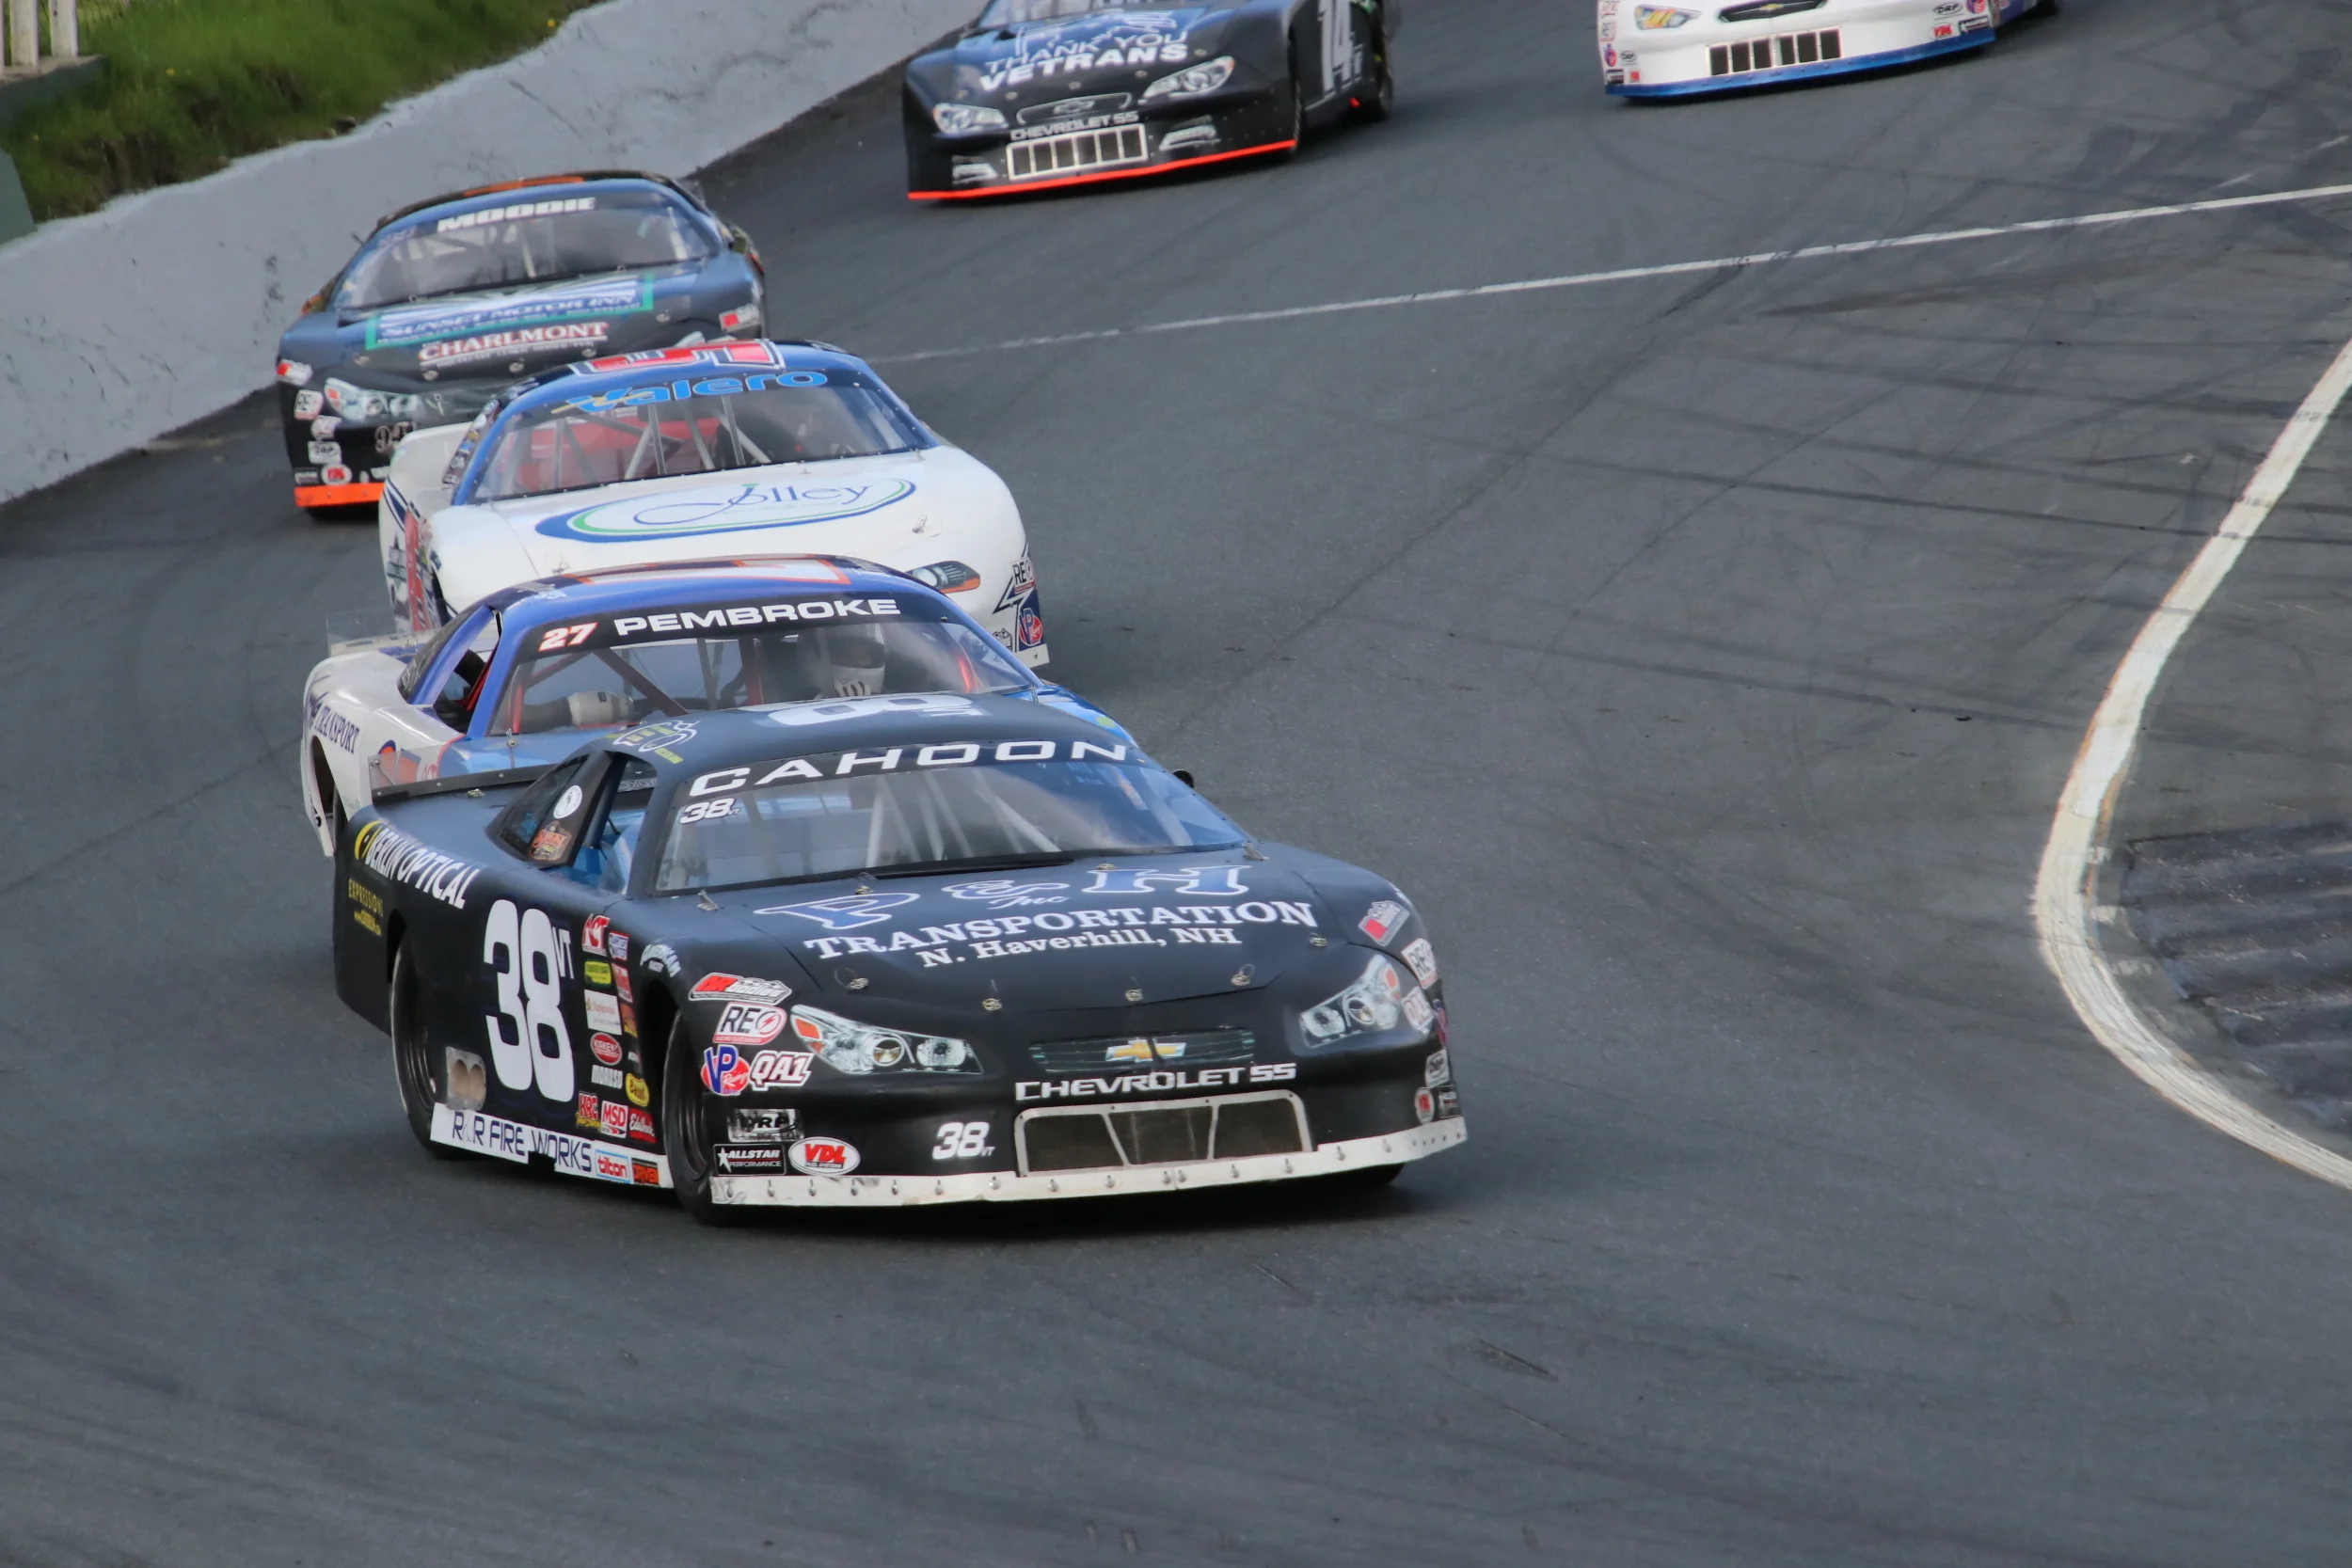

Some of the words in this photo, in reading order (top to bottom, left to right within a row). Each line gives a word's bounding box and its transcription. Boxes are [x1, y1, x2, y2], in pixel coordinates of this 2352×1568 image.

[978, 42, 1188, 92] VETRANS
[984, 41, 1099, 75] THANK
[1112, 30, 1188, 50] YOU
[1010, 115, 1111, 141] CHEVROLET
[437, 198, 596, 233] MOODIE
[419, 321, 610, 361] CHARLMONT
[564, 371, 829, 414] Valero
[537, 622, 598, 653] 27
[613, 599, 900, 637] PEMBROKE
[314, 705, 361, 755] TRANSPORT
[688, 740, 1127, 798] CAHOON
[679, 798, 736, 824] 38
[396, 847, 481, 910] OPTICAL
[1082, 864, 1252, 895] H
[988, 895, 1071, 910] Inc
[803, 900, 1318, 959] TRANSPORTATION
[915, 949, 966, 968] N.
[971, 928, 1168, 959] Haverhill,
[1169, 927, 1243, 944] NH
[484, 898, 576, 1103] 38
[551, 926, 575, 980] VT
[704, 1045, 739, 1094] VP
[752, 1053, 809, 1089] QA1
[1015, 1067, 1247, 1102] CHEVROLET
[1249, 1061, 1297, 1084] SS
[579, 1092, 598, 1120] KRC
[603, 1101, 628, 1128] MSD
[489, 1120, 526, 1157] FIRE
[531, 1130, 593, 1173] WORKS
[727, 1149, 781, 1160] ALLSTAR
[805, 1143, 847, 1164] VDL
[932, 1121, 991, 1160] 38
